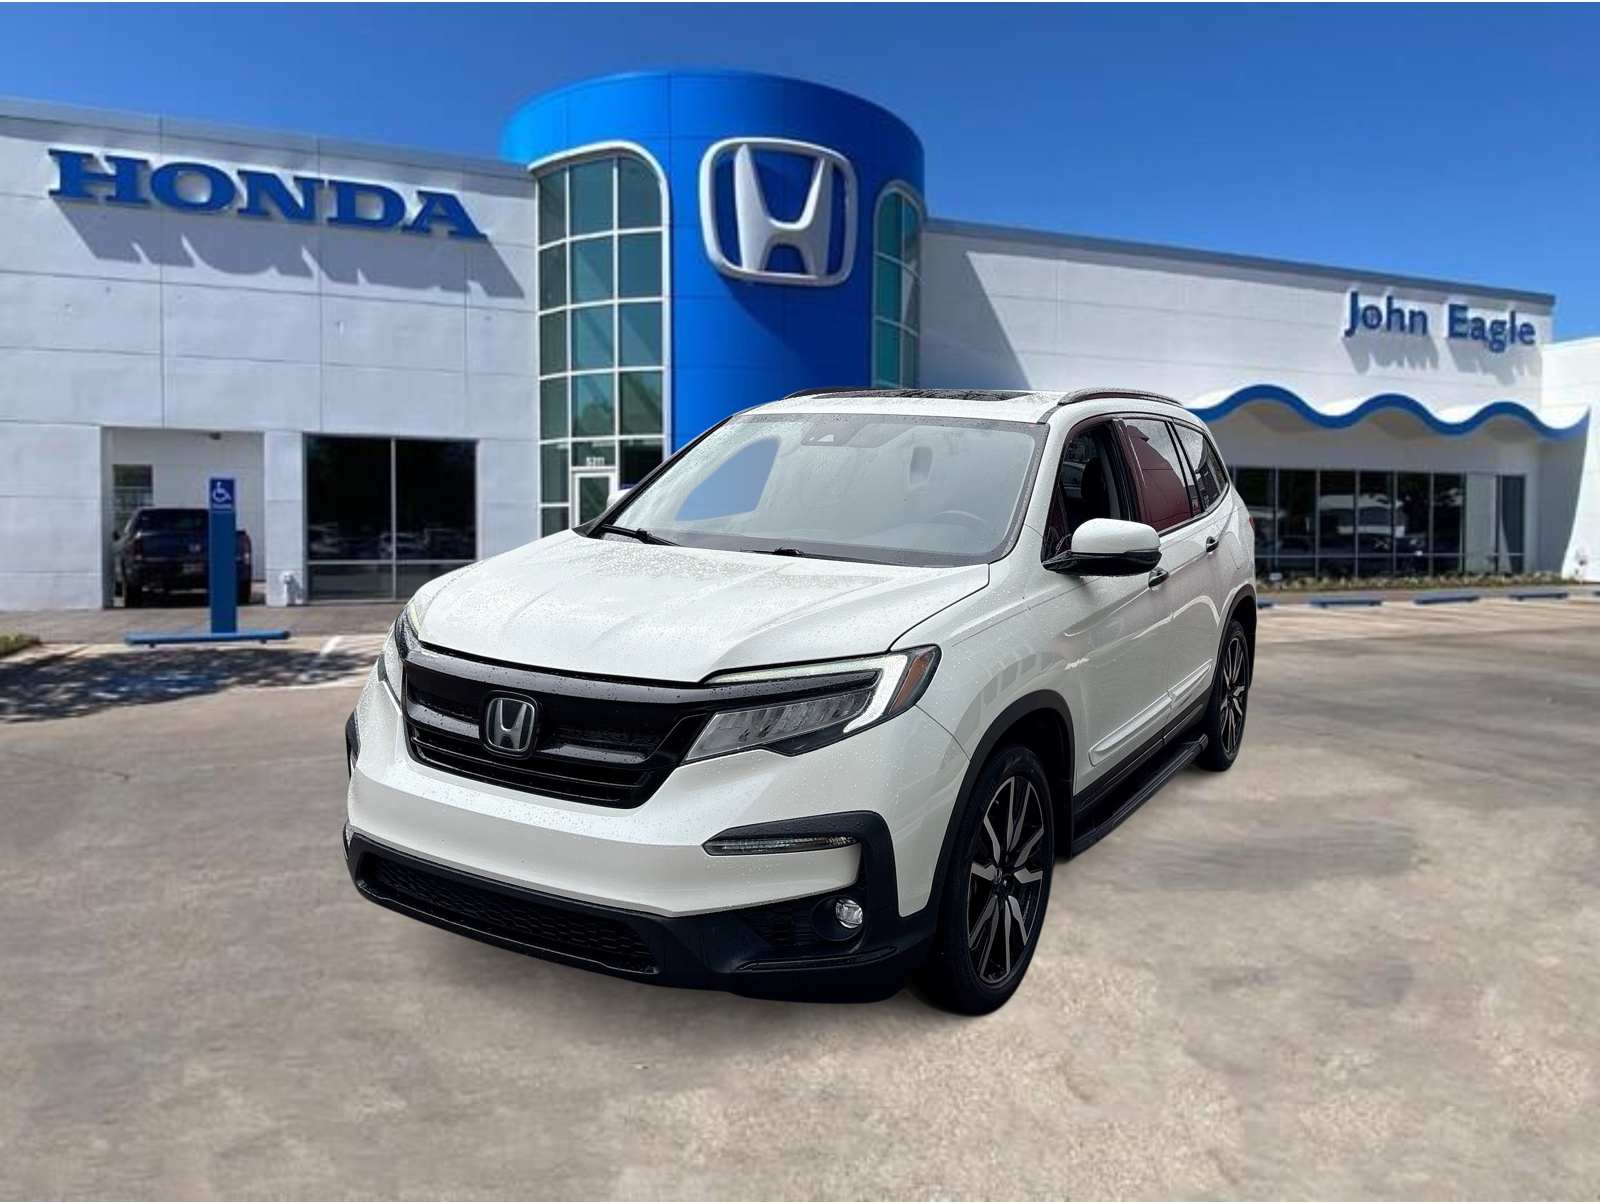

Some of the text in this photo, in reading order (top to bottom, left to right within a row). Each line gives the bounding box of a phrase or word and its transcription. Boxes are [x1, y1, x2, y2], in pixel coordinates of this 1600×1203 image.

[48, 148, 488, 241] HONDA
[1344, 290, 1536, 353] John Eagle
